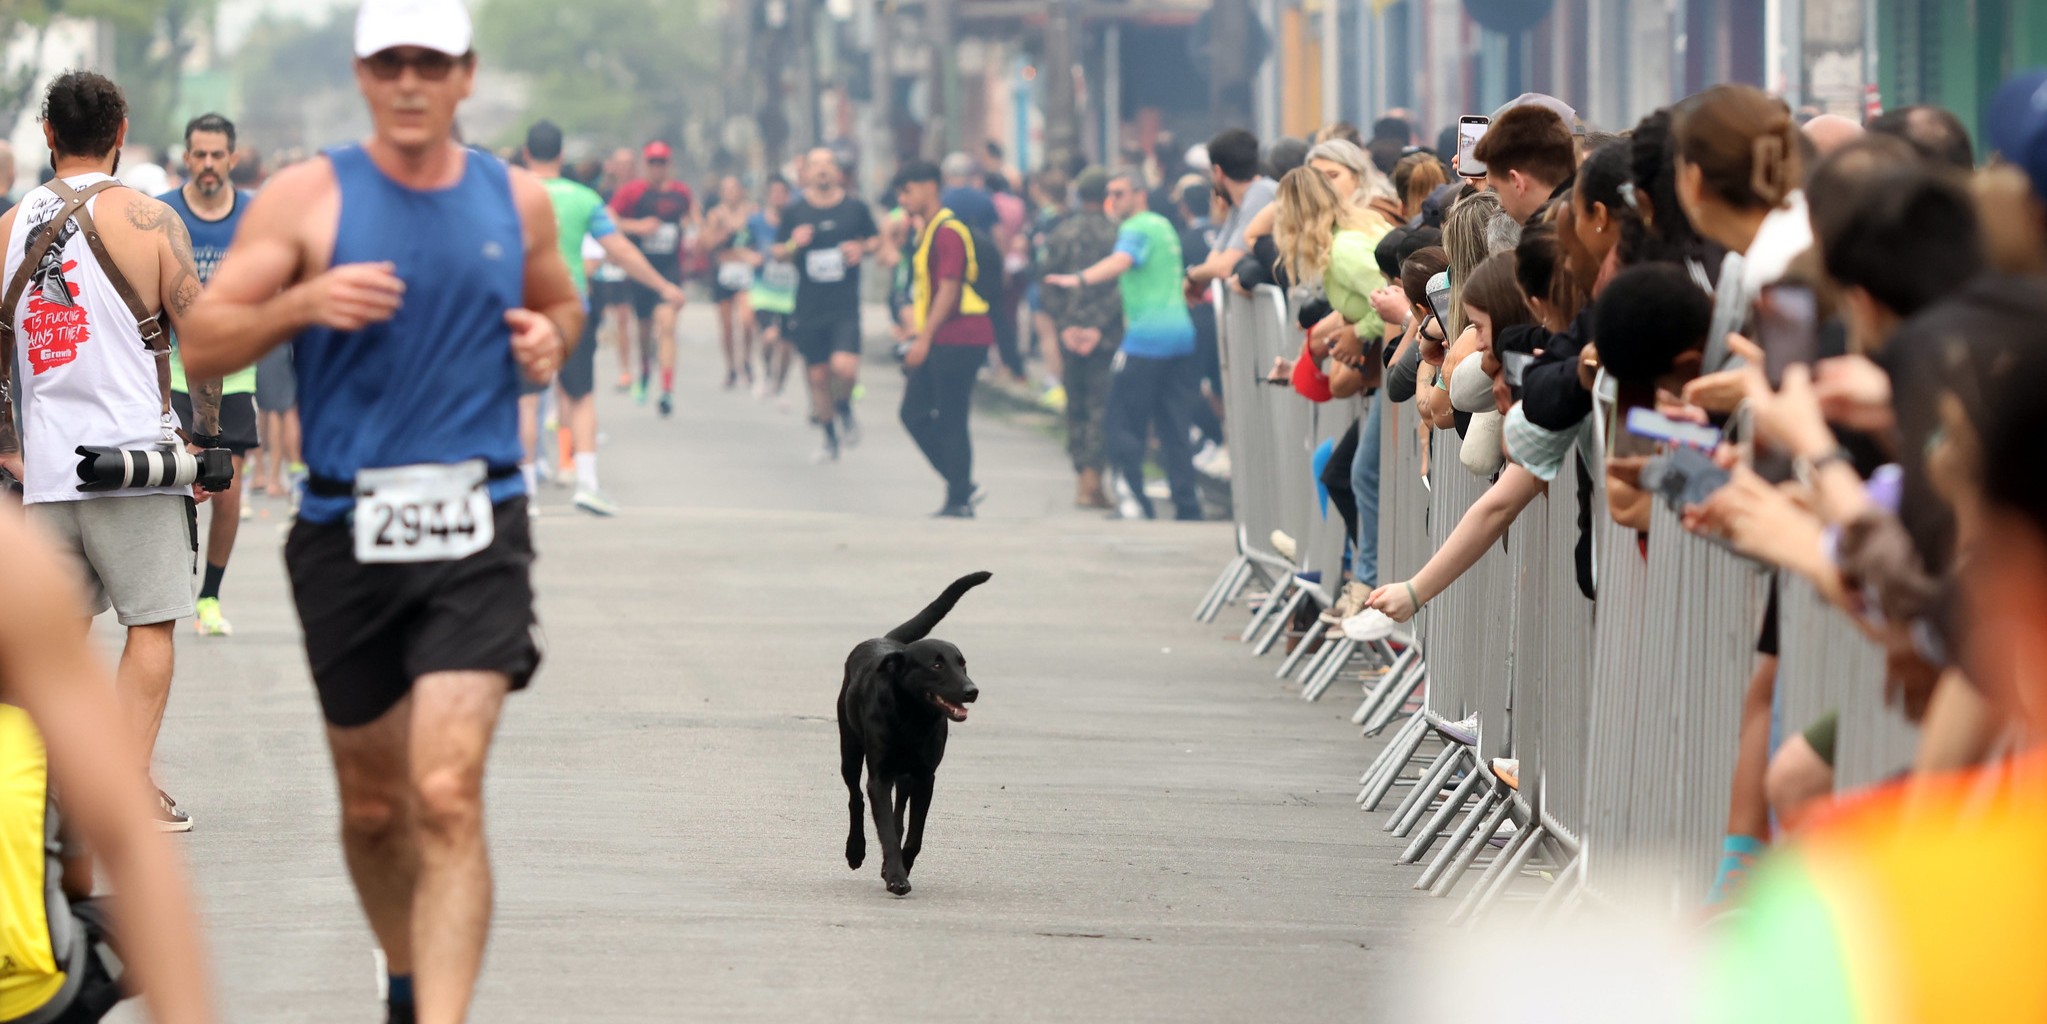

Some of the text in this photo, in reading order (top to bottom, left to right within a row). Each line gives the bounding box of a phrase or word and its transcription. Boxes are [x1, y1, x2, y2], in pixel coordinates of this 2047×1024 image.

[31, 309, 80, 330] IS FUCKING
[40, 348, 72, 360] Growth
[374, 499, 475, 546] 2944
